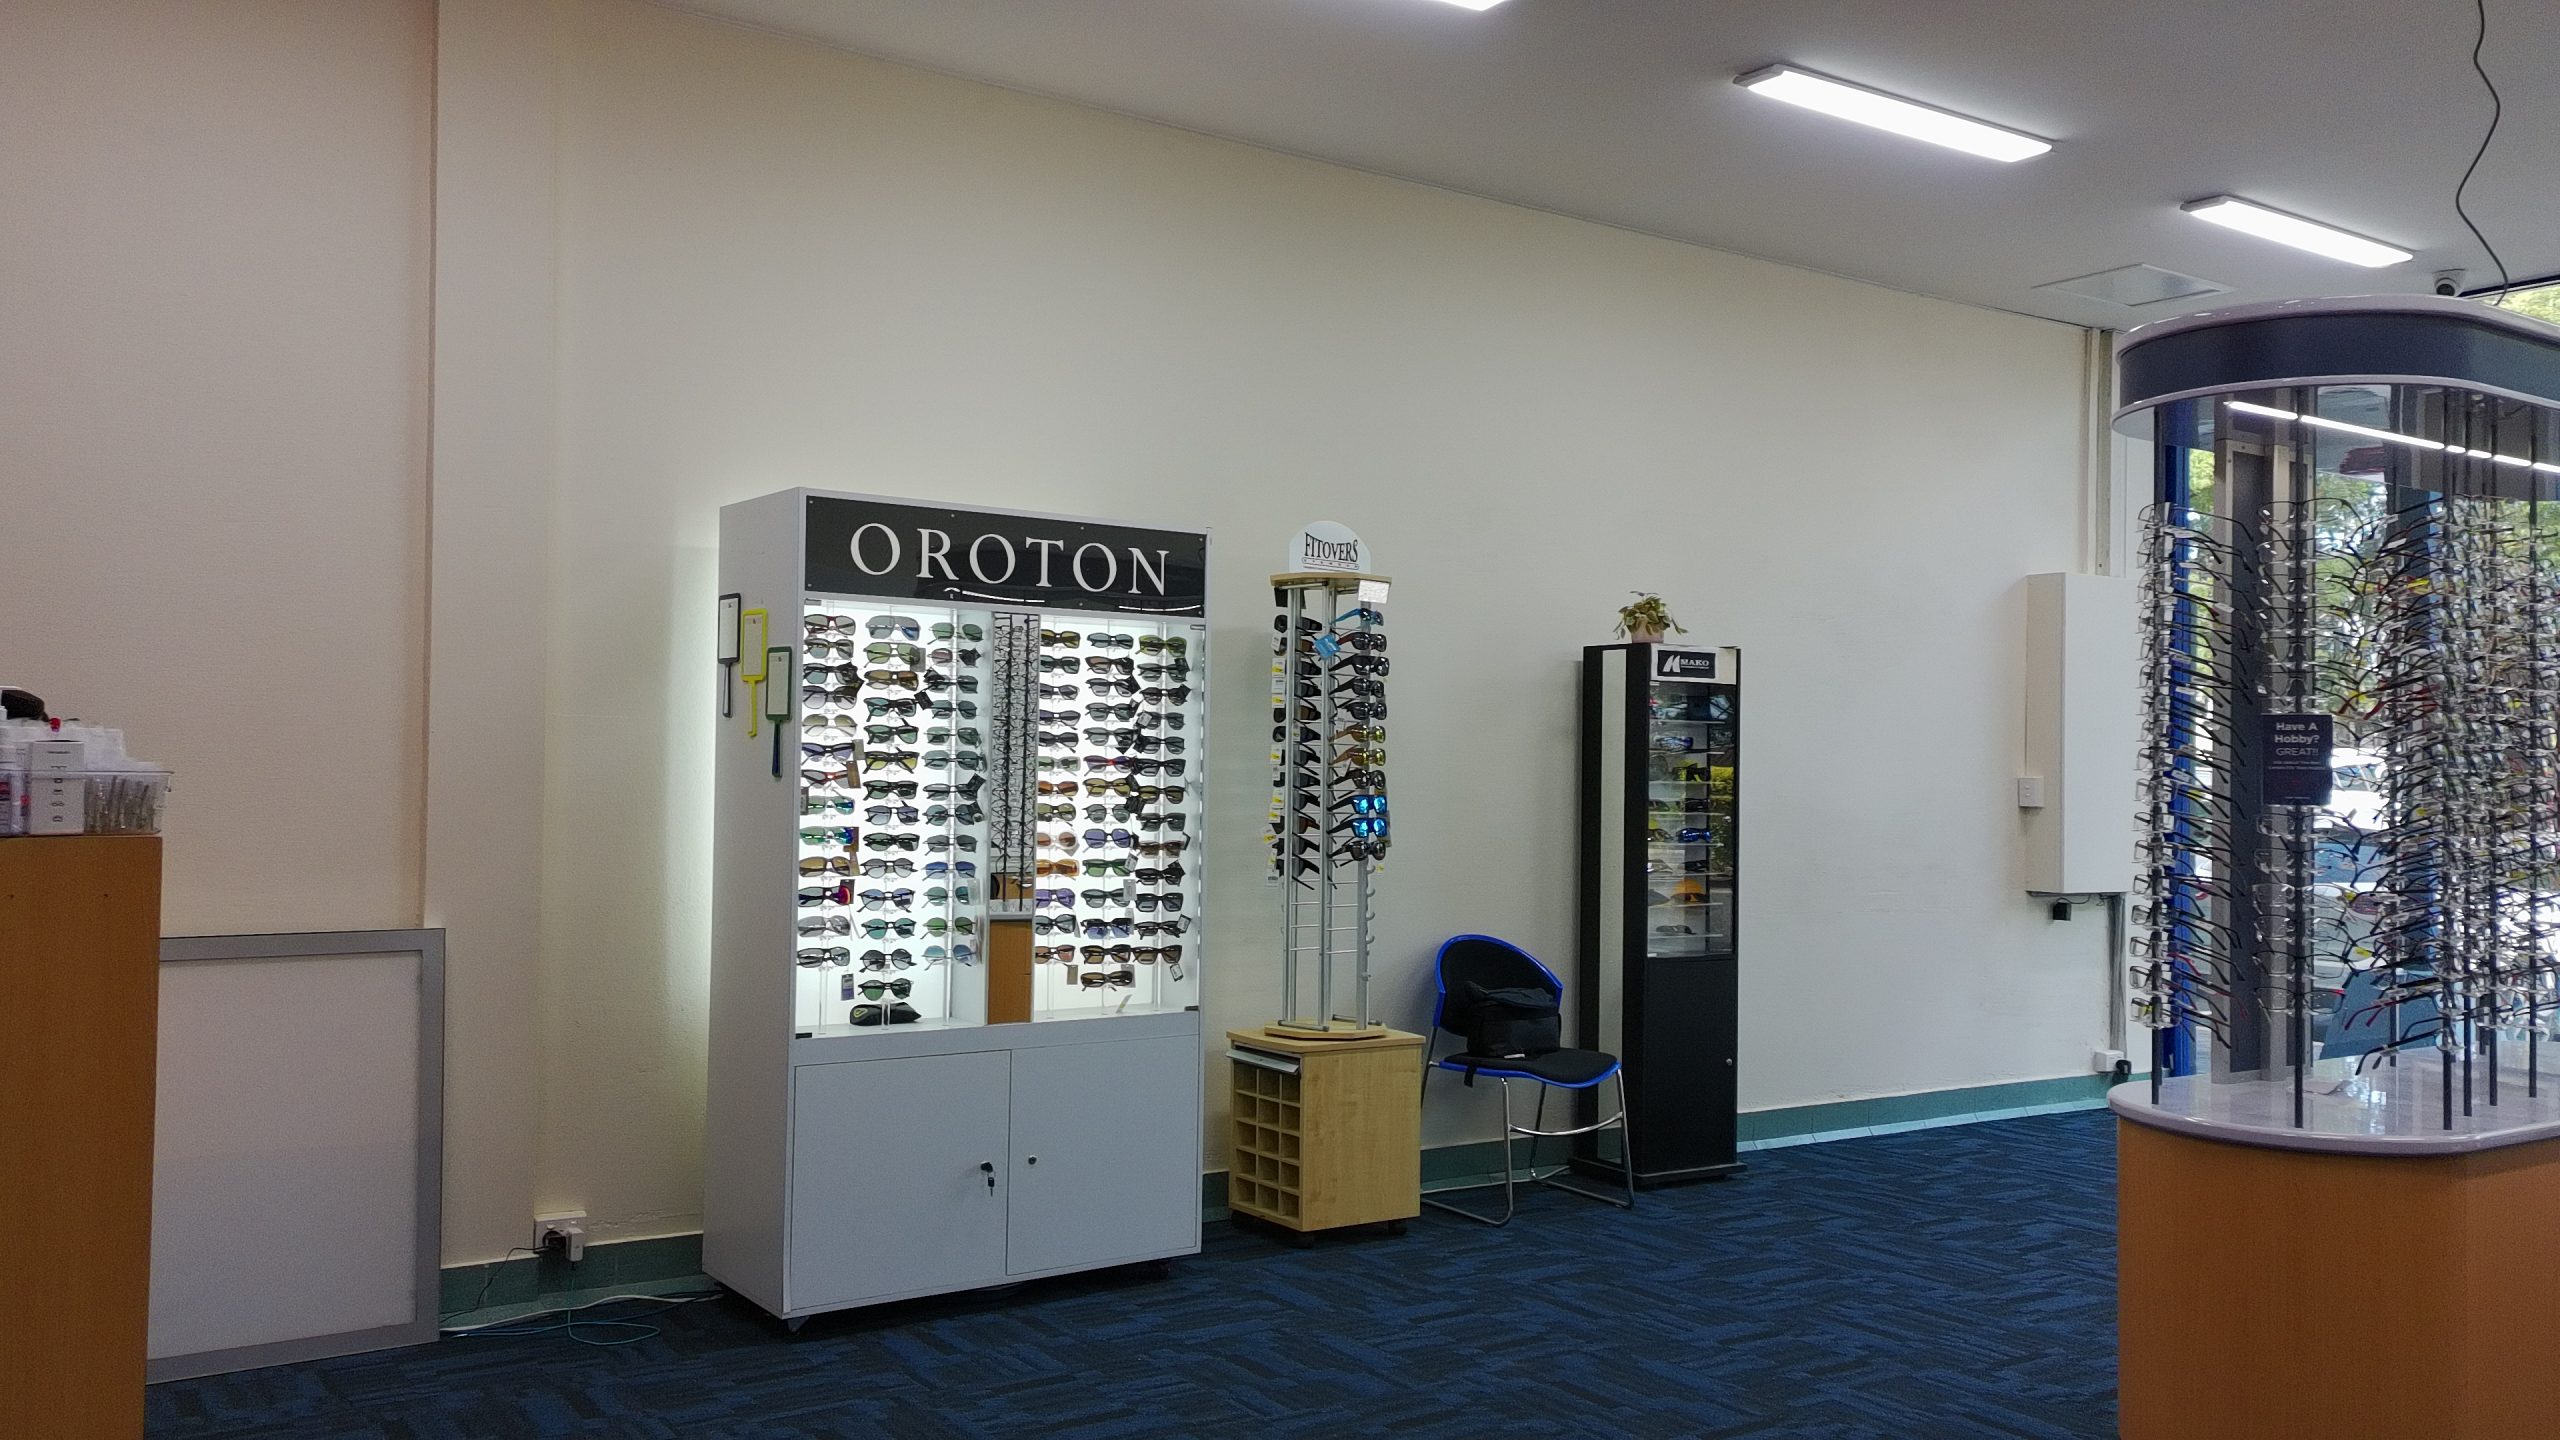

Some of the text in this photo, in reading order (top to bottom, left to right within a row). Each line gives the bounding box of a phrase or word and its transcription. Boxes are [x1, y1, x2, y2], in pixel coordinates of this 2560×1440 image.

[1304, 532, 1359, 563] FITOVERS
[850, 522, 1170, 596] OROTON
[2275, 722, 2319, 731] Have A
[2274, 734, 2320, 745] Hobby?
